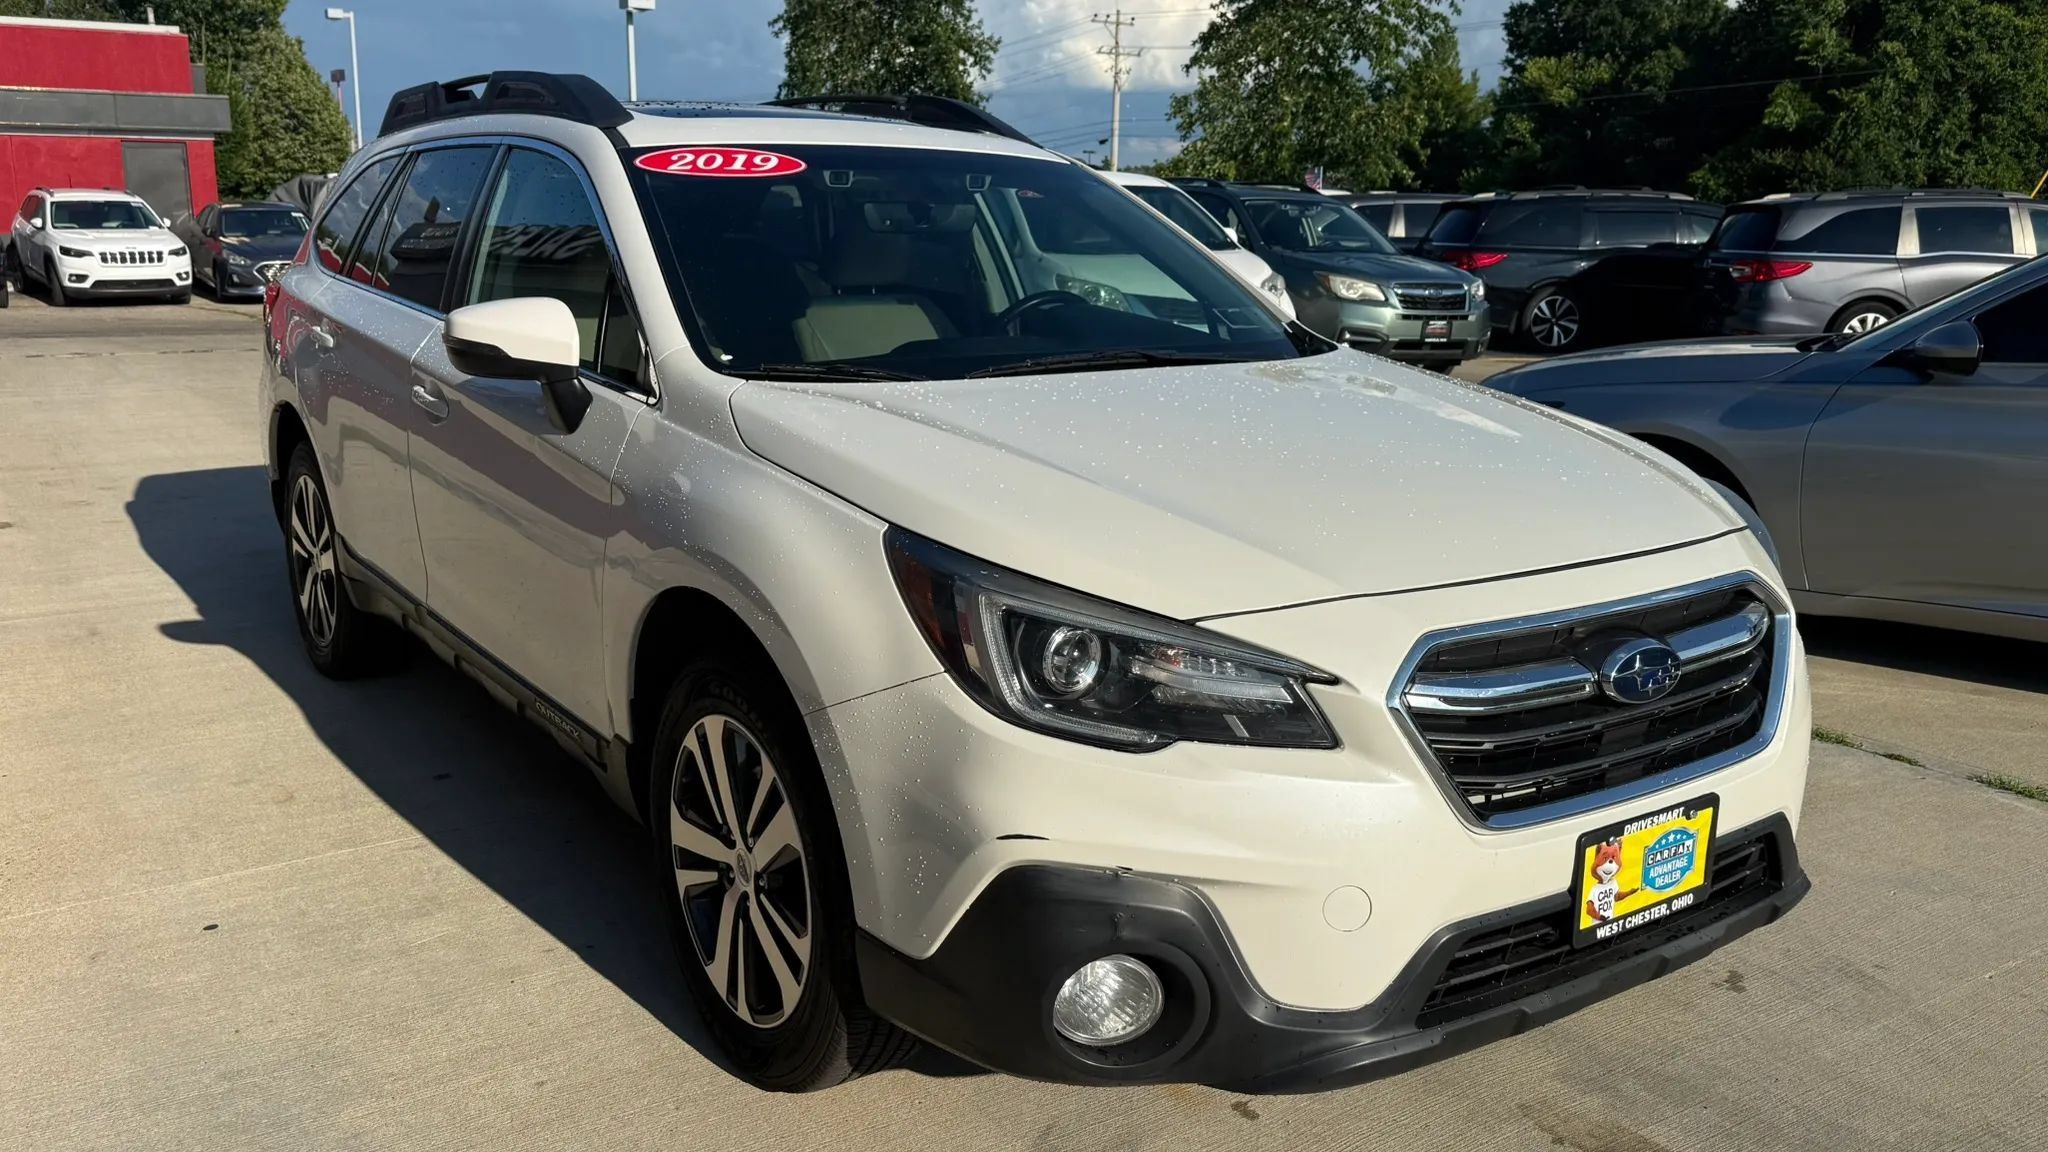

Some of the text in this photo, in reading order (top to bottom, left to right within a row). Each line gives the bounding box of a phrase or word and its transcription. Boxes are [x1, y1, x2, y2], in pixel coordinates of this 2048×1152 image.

[667, 152, 779, 171] 2019
[1624, 807, 1685, 835] DRIVESMART
[1647, 839, 1693, 865] CARFAX
[1649, 856, 1688, 879] ADVANTAGE
[1655, 870, 1681, 888] DEALER
[1598, 888, 1613, 902] CAR
[1596, 893, 1694, 939] WEST CHESTER, OHIO
[1598, 900, 1613, 912] FOX
